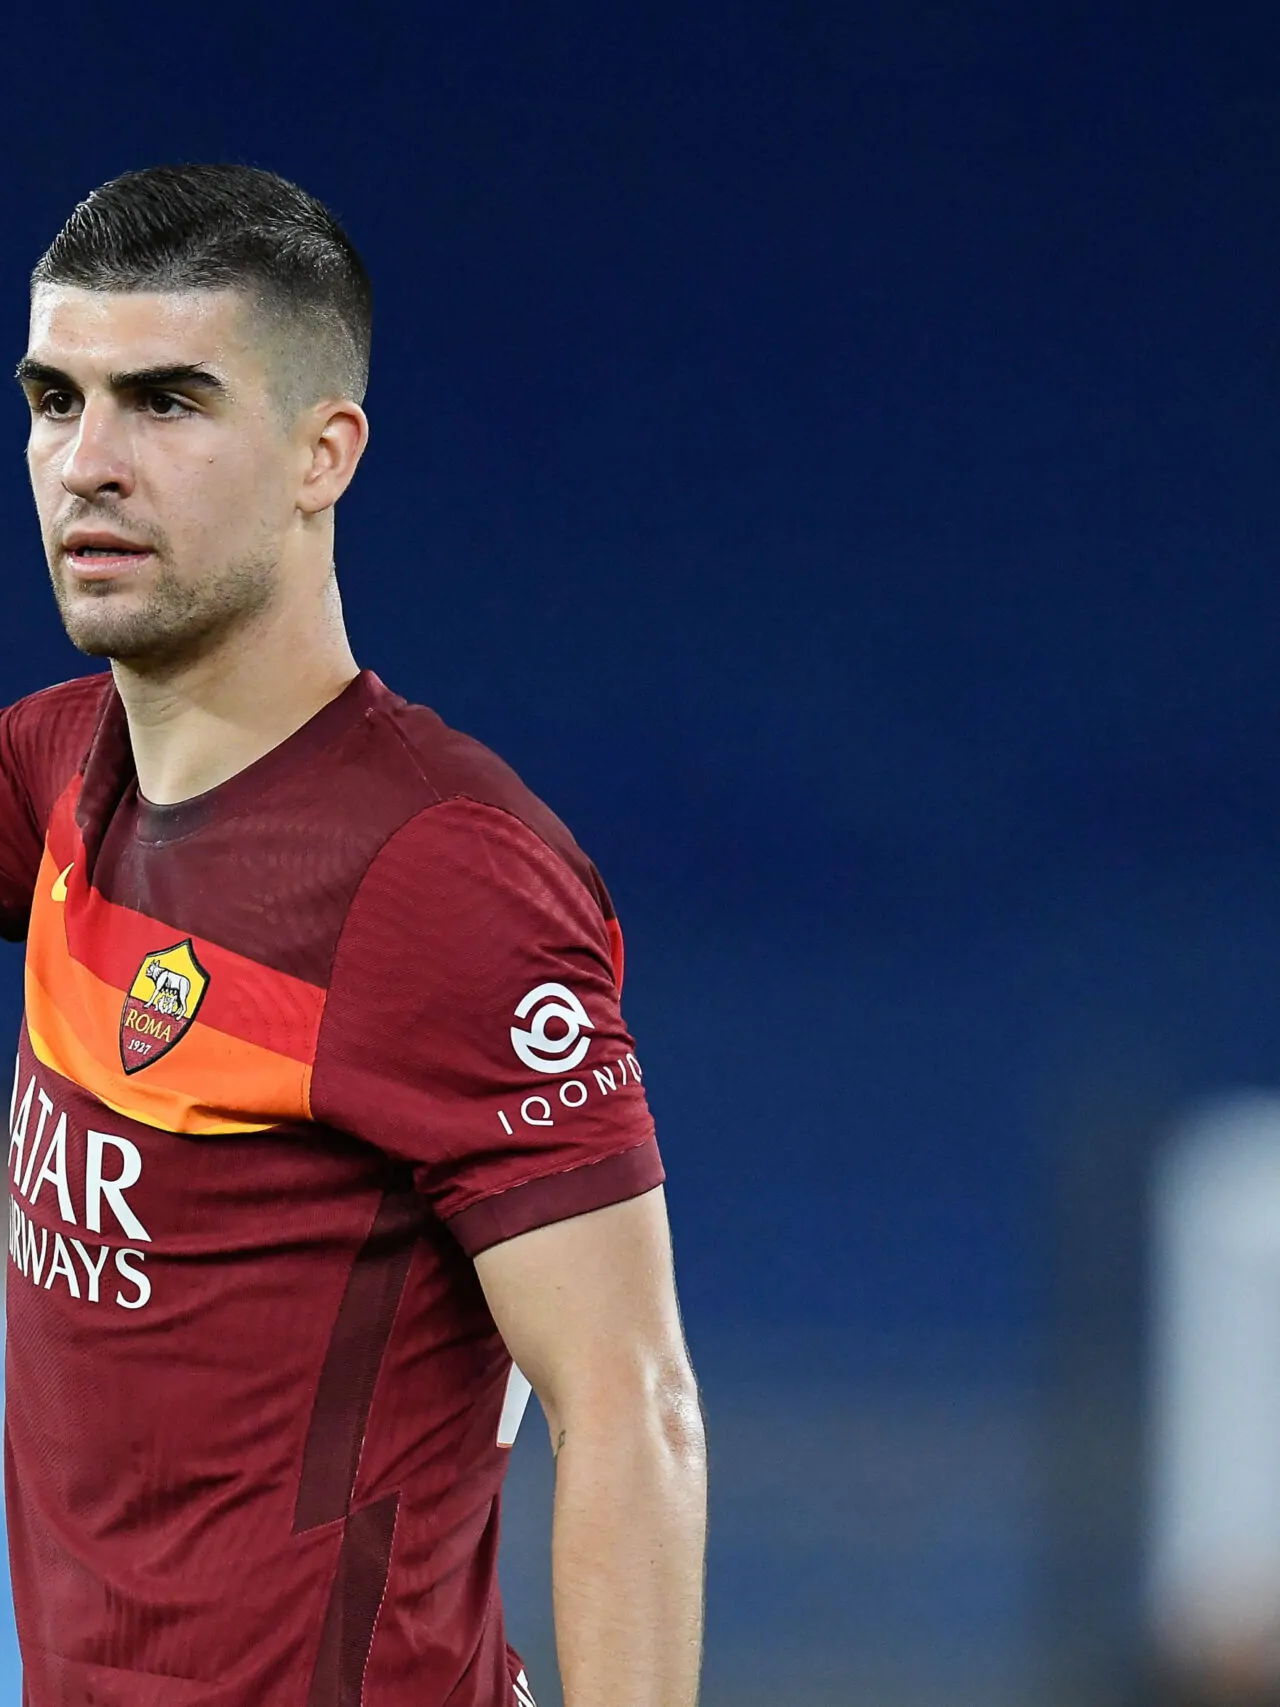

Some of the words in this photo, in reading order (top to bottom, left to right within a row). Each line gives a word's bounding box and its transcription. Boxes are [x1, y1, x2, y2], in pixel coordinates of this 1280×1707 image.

[124, 1008, 173, 1043] ROMA
[127, 1038, 152, 1056] 1927
[6, 1052, 152, 1243] ATAR
